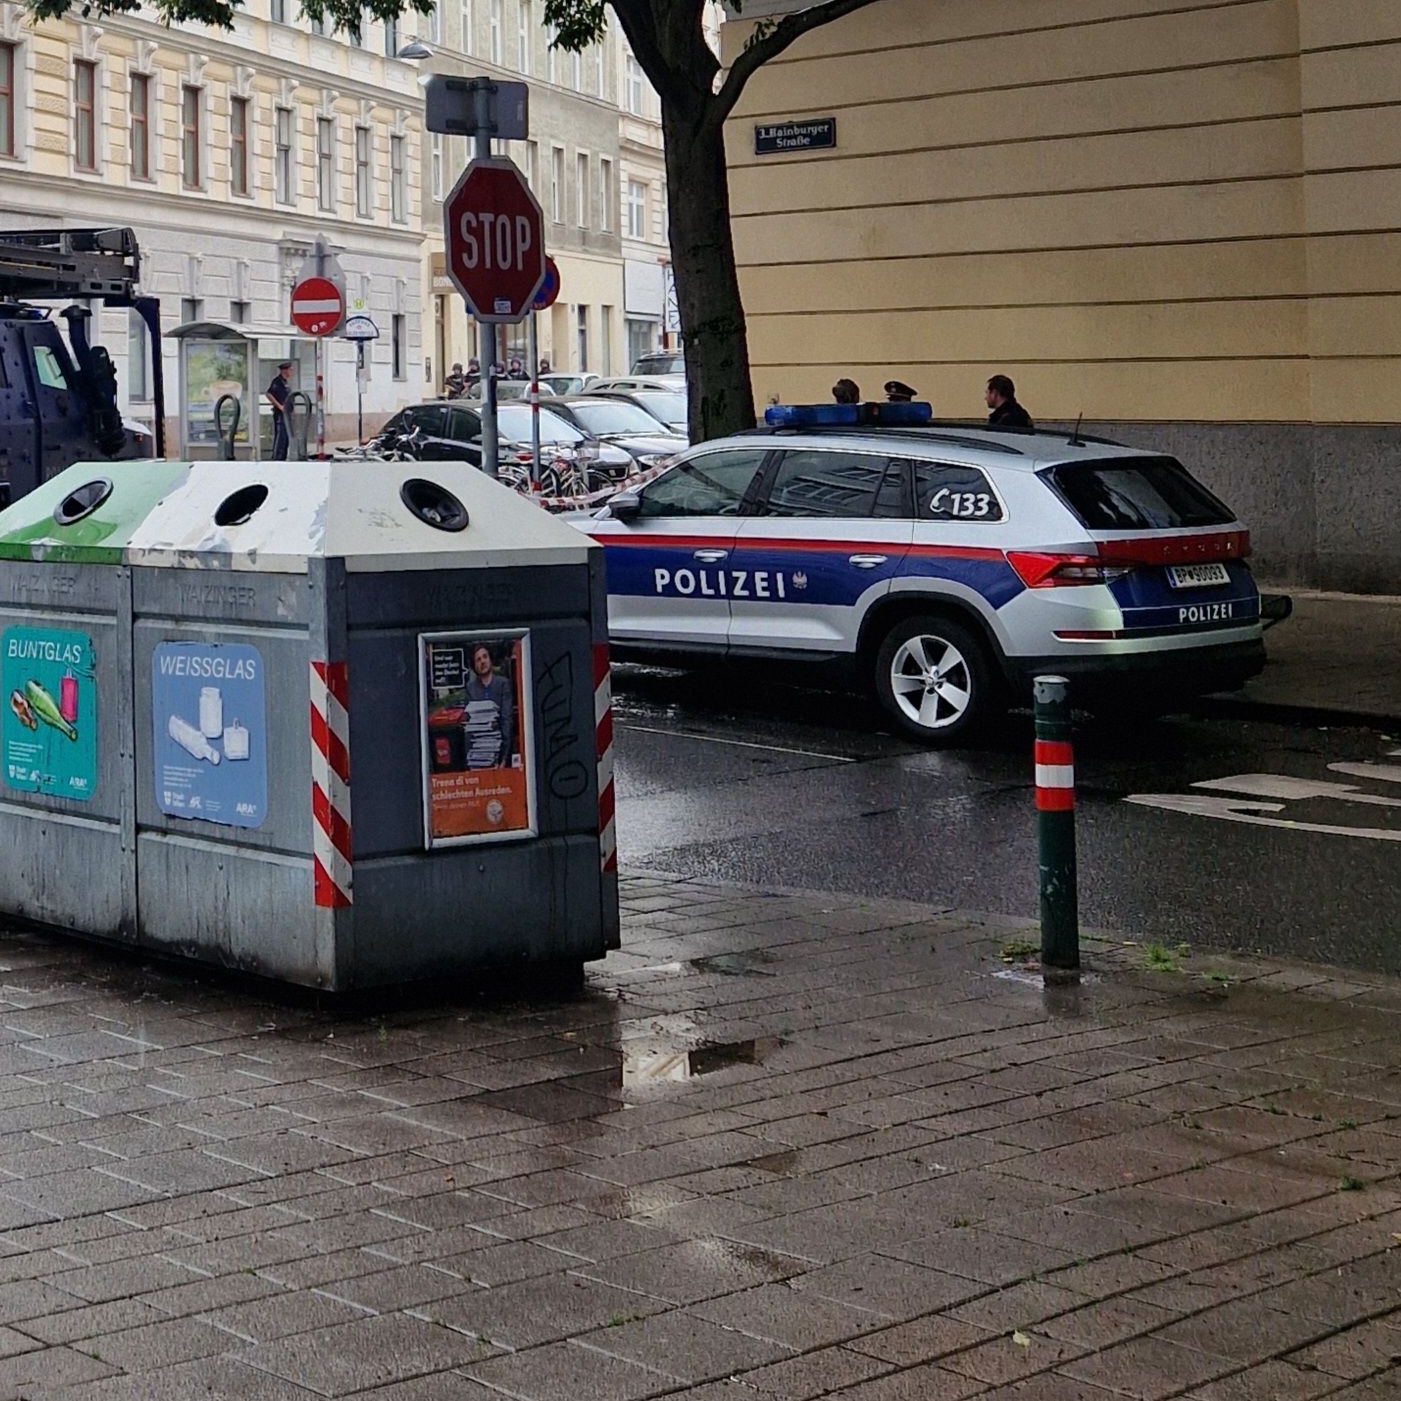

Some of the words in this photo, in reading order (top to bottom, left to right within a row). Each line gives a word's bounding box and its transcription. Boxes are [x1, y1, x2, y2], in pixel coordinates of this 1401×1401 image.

[776, 136, 811, 148] Straße
[460, 211, 532, 271] STOP
[950, 492, 990, 516] 133
[654, 568, 786, 599] POLIZEI
[1179, 603, 1233, 623] POLIZEI
[7, 639, 82, 664] BUNTGLAS
[160, 655, 257, 680] WEISSGLAS
